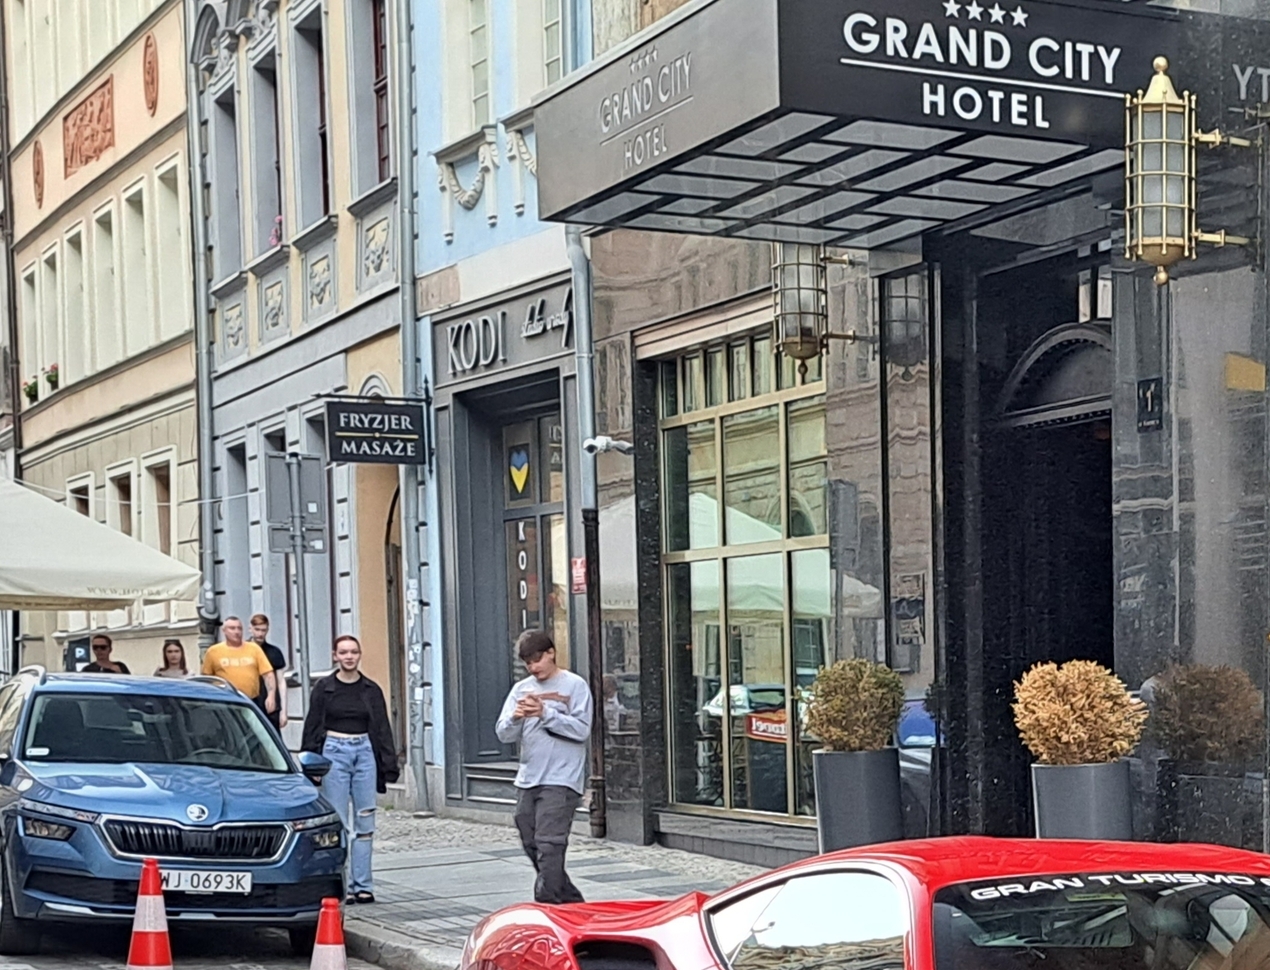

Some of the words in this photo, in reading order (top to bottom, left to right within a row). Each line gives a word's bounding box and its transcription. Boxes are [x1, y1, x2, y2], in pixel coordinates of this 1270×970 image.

[843, 12, 1012, 70] GRAND
[1028, 37, 1121, 84] CITY
[601, 76, 653, 134] GRAND
[657, 51, 692, 103] CITY
[922, 82, 1050, 129] HOTEL
[624, 123, 668, 170] HOTEL
[446, 311, 507, 374] KODI
[339, 413, 414, 432] FRYZJER
[341, 439, 416, 456] MASAŻE
[518, 521, 528, 629] KODI
[190, 873, 247, 891] 0693K
[970, 878, 1085, 901] GRAN
[1088, 873, 1255, 886] TURISMO
